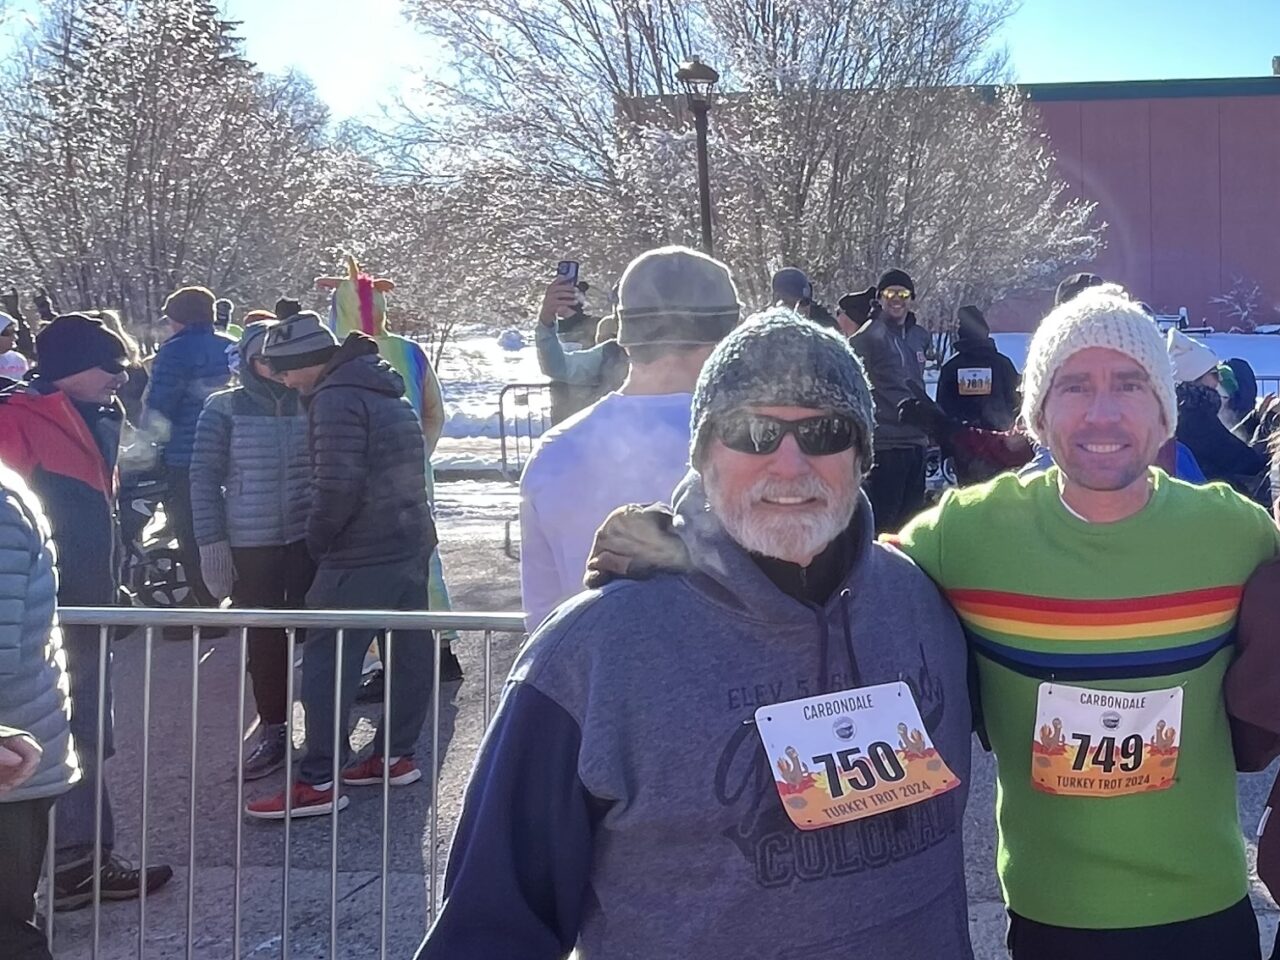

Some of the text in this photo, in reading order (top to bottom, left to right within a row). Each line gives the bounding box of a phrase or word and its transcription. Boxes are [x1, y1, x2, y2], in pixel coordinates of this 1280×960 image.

[728, 681, 783, 710] ELEV
[803, 694, 873, 720] CARBONDALE
[1080, 693, 1146, 709] CARBONDALE
[1071, 733, 1143, 773] 749
[812, 741, 905, 798] 750
[1057, 774, 1150, 790] TURKEY TROT 2024
[822, 779, 931, 820] TURKEY TROT 2024
